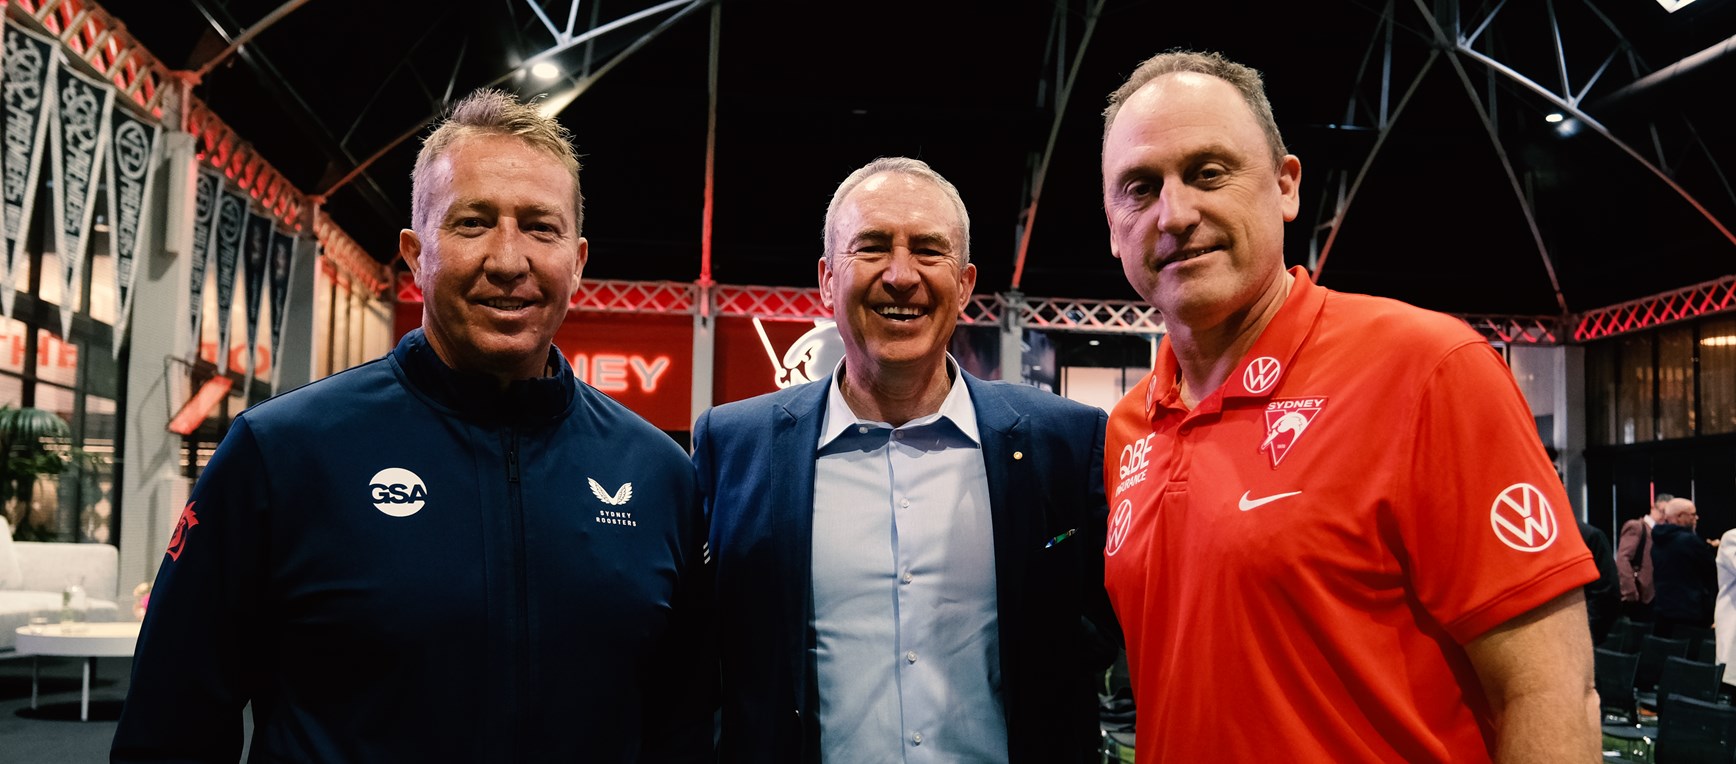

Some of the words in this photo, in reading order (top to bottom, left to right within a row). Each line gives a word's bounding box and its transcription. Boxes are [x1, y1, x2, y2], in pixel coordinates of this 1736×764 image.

[4, 104, 33, 204] PREMIERS
[118, 126, 147, 173] VFL
[65, 145, 91, 236] PREMIERS
[118, 175, 141, 257] PREMIERS
[1267, 398, 1325, 411] SYDNEY
[1119, 432, 1156, 480] QBE
[369, 483, 428, 504] GSA
[600, 510, 631, 519] SYDNEY
[595, 516, 637, 527] ROOSTERS
